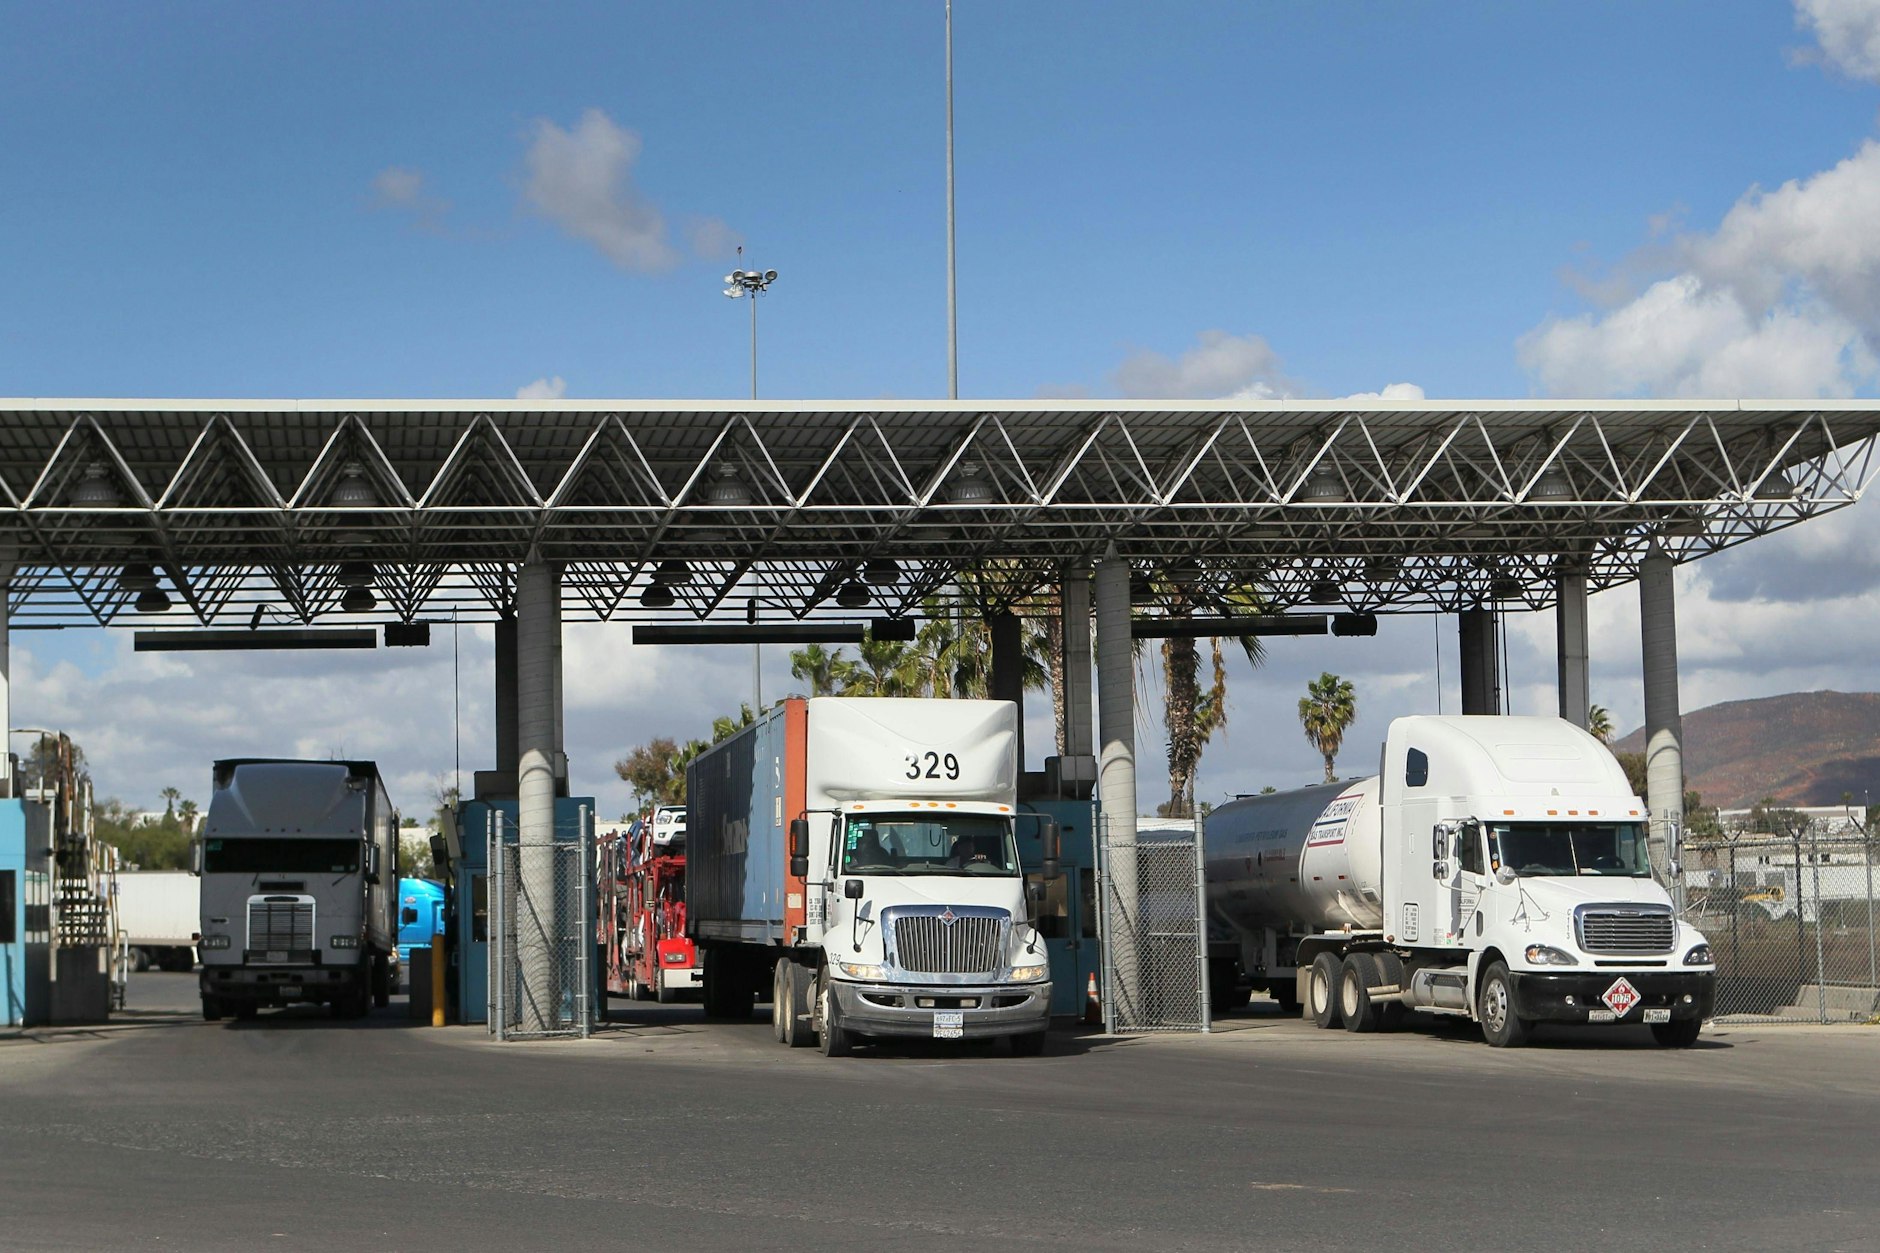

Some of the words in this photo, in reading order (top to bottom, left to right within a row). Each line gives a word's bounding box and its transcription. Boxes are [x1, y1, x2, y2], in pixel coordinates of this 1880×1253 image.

[905, 751, 960, 781] 329
[829, 952, 842, 967] 329
[1613, 993, 1630, 1003] 1075
